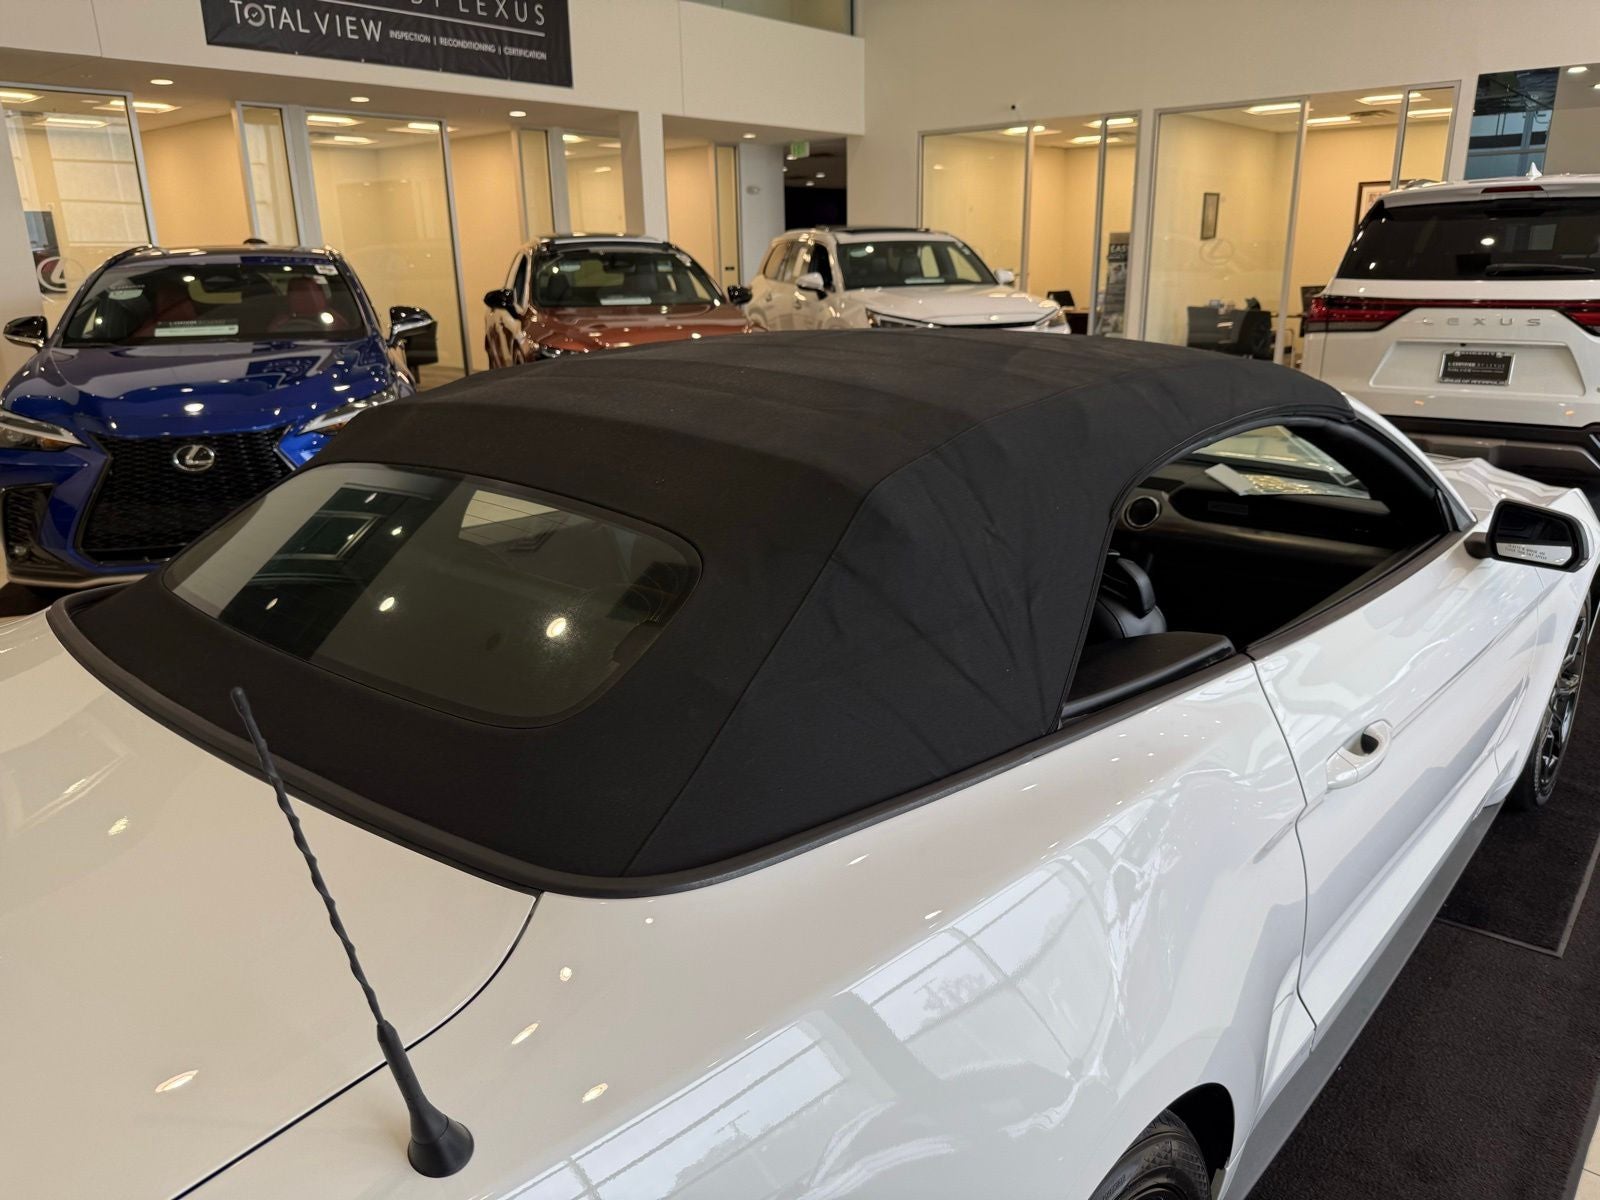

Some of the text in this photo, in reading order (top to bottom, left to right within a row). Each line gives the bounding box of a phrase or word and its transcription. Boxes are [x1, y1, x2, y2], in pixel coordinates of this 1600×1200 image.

[458, 0, 545, 25] LEXUS
[230, 0, 547, 60] TOTAL VIEW INSPECTION RECONDITIONING CERTIFICATION
[1422, 317, 1541, 327] LEXUS
